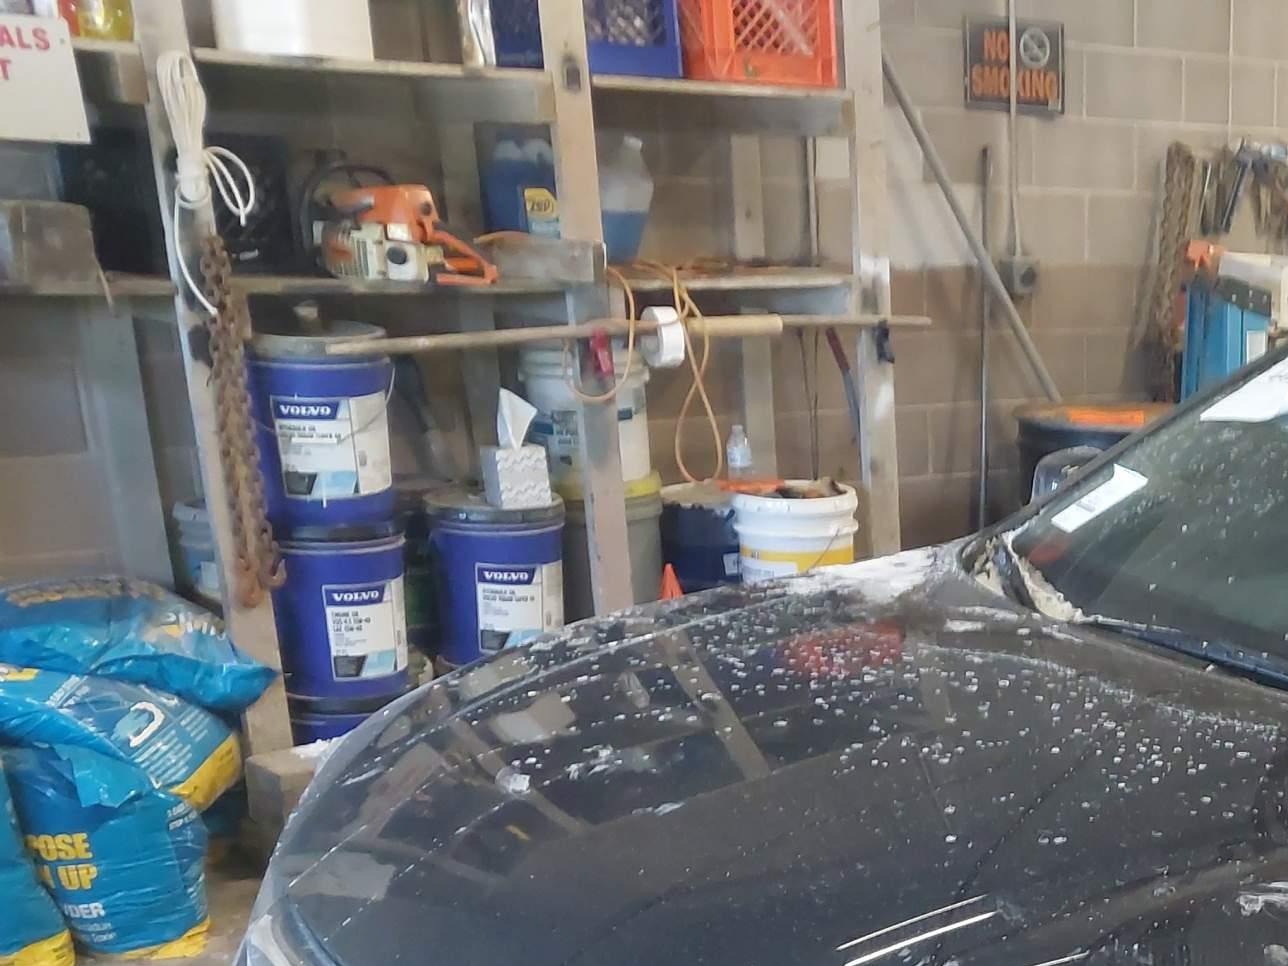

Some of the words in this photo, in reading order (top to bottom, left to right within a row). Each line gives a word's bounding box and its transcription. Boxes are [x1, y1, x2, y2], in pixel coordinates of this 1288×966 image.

[984, 30, 1009, 63] NO
[280, 404, 332, 416] VOLVO
[483, 570, 529, 581] VOLVO
[331, 590, 380, 602] VOLVO
[57, 864, 98, 890] UP
